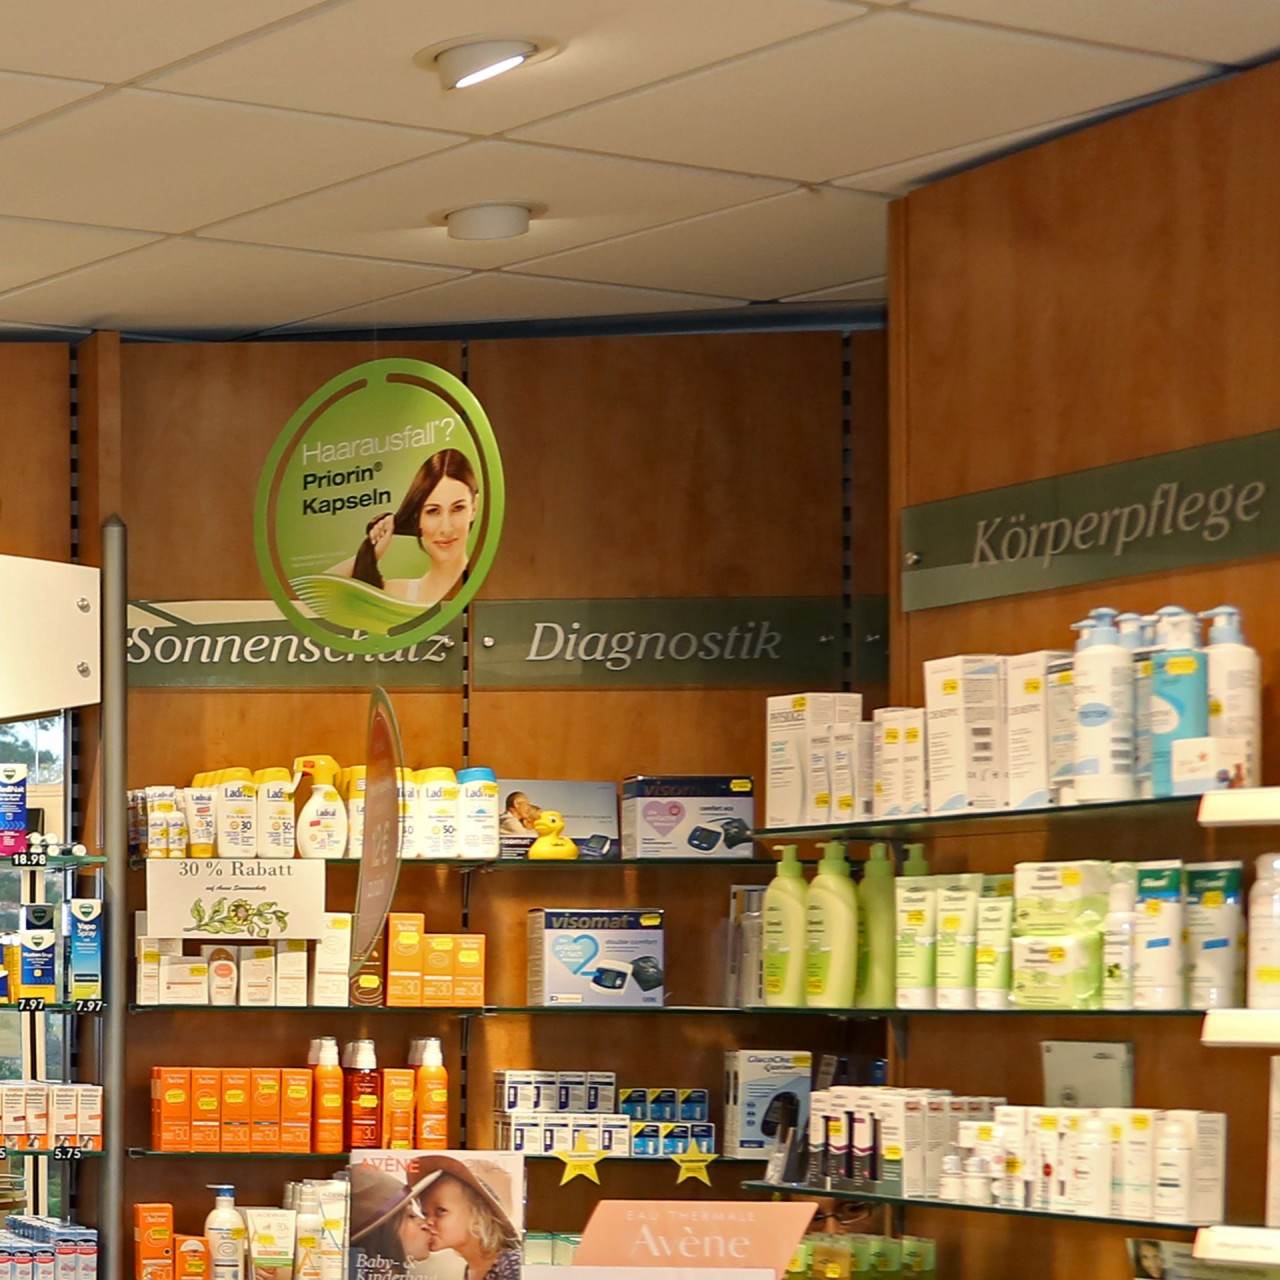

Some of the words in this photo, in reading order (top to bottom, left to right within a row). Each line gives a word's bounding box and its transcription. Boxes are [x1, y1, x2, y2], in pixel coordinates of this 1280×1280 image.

[302, 488, 391, 515] Kapseln
[971, 480, 1264, 568] Körperpflege
[527, 622, 782, 670] Diagnostik
[13, 854, 46, 864] 18.98
[179, 861, 203, 877] 30
[207, 861, 225, 877] %
[231, 861, 293, 877] Rabatt
[551, 912, 632, 930] visomat
[55, 1148, 81, 1158] 5.75
[360, 1157, 419, 1173] AVÈNE
[627, 1211, 658, 1222] EAU
[669, 1211, 756, 1222] THERMALE
[632, 1228, 751, 1259] Avène
[357, 1254, 400, 1271] Baby-
